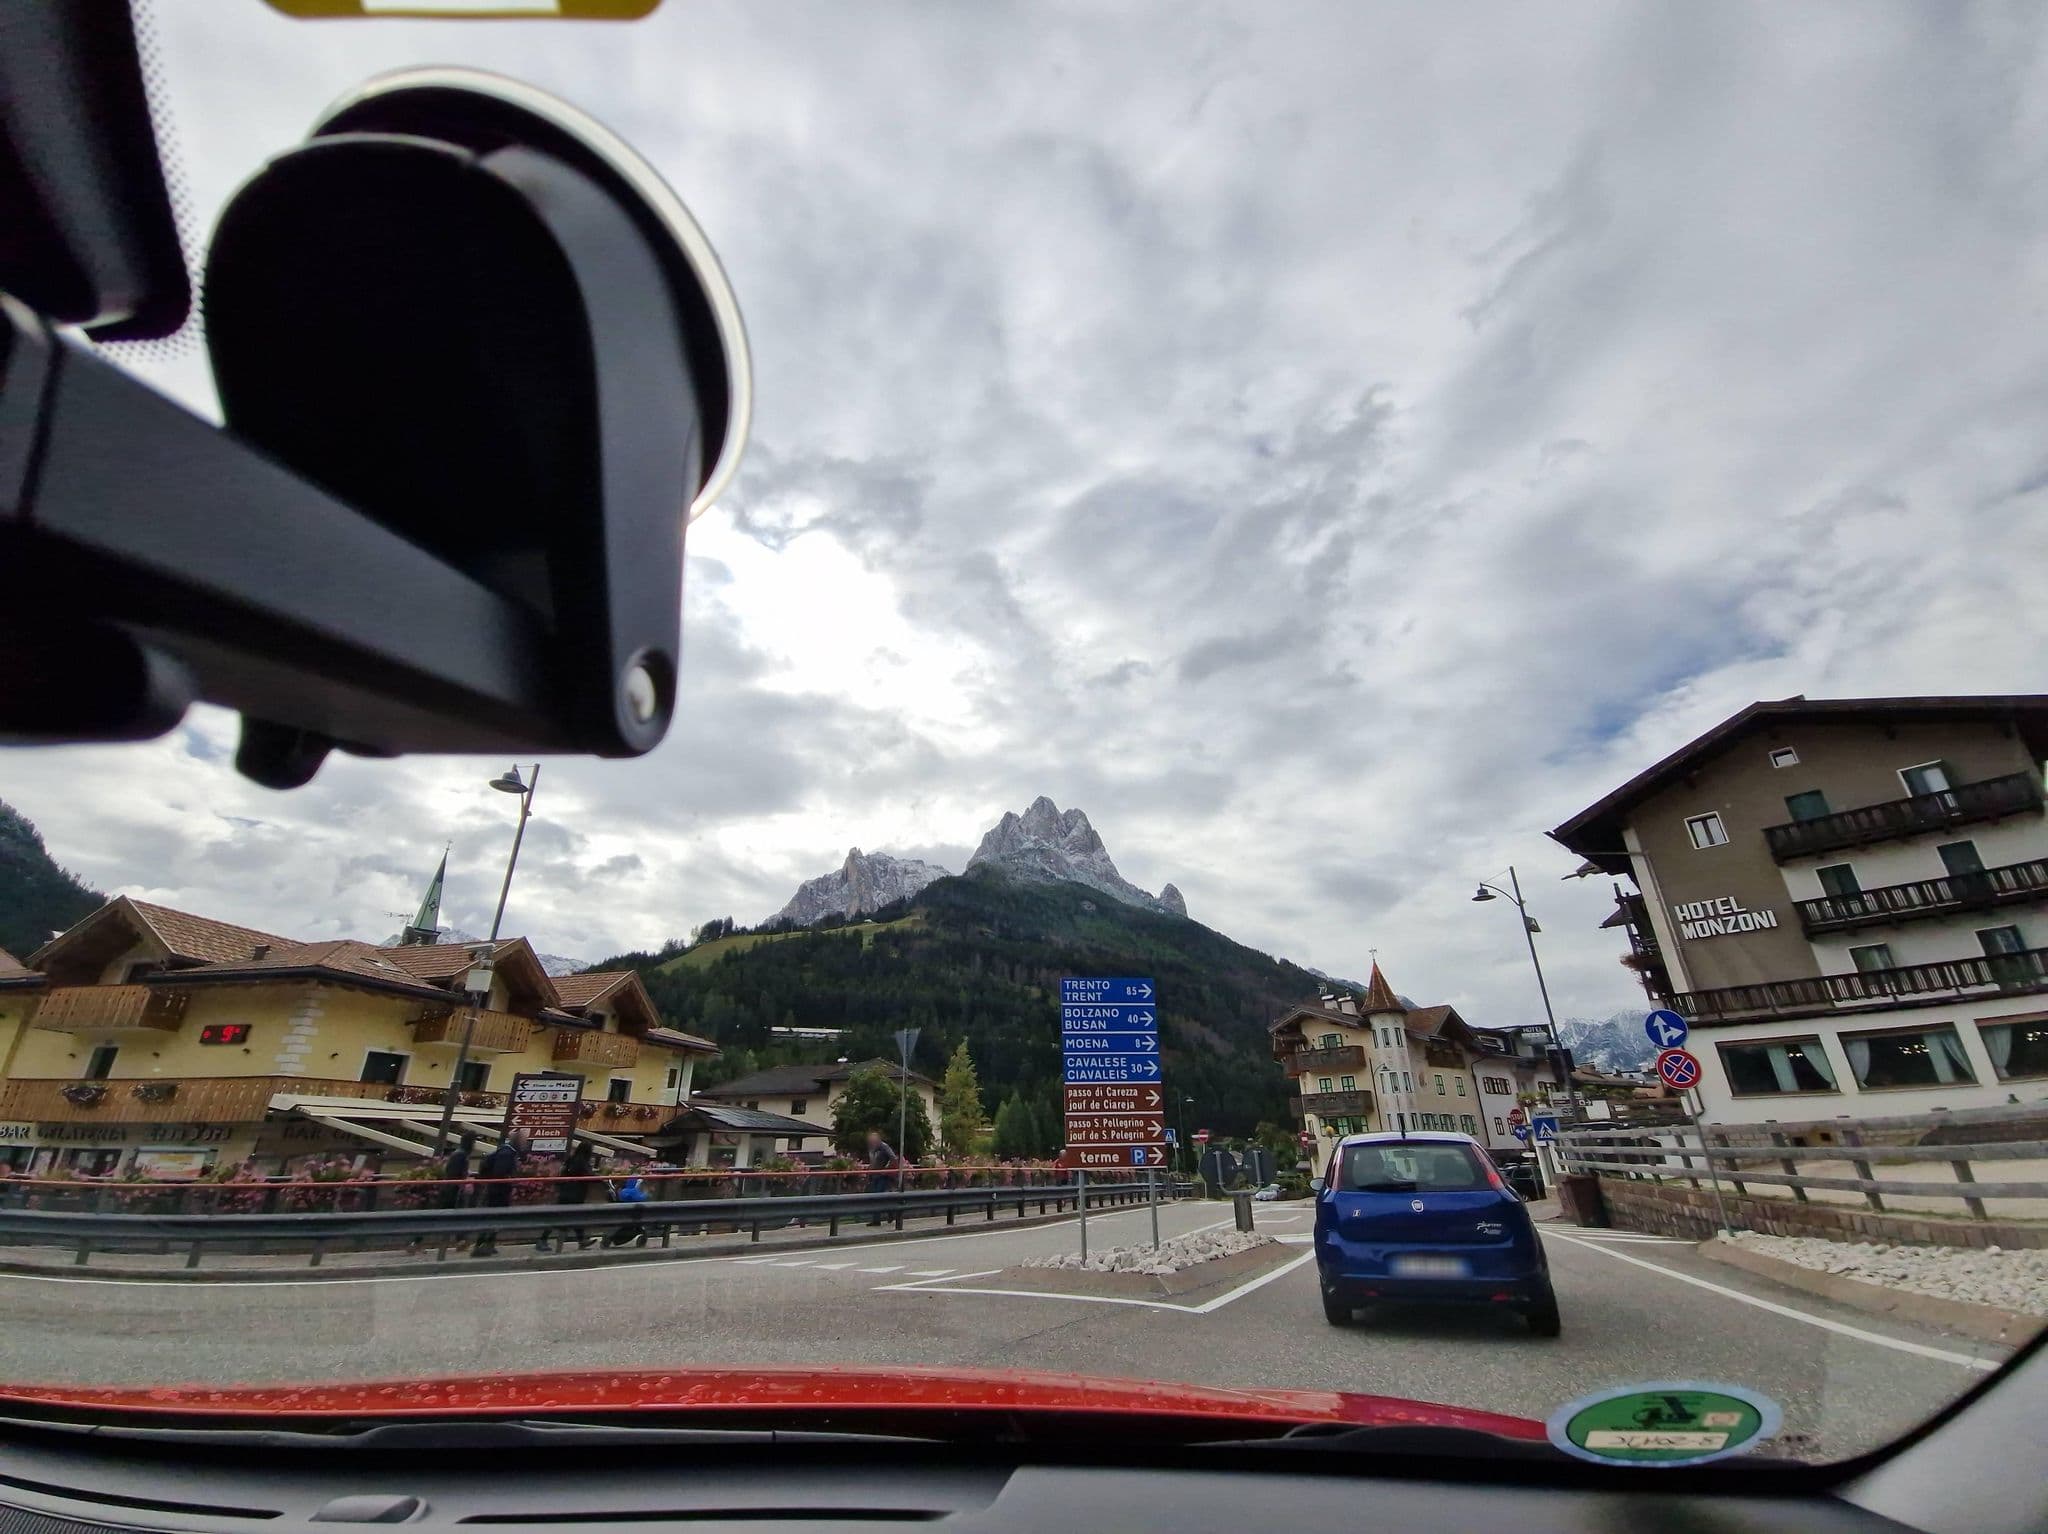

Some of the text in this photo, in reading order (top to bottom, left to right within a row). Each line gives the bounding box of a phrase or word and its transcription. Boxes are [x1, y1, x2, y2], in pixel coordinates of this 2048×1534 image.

[1674, 896, 1747, 921] HOTEL
[1680, 910, 1778, 940] MONZONI
[1064, 980, 1110, 990] TRENTO
[1064, 991, 1102, 1001] TRENT
[1126, 986, 1137, 996] 85
[1064, 1008, 1119, 1018] BOLZANO
[1127, 1014, 1138, 1024] 40
[1065, 1020, 1106, 1030] BUSAN
[1065, 1039, 1109, 1049] MOENA
[1135, 1038, 1141, 1048] 8
[1067, 1057, 1127, 1067] CAVALESE
[1130, 1063, 1143, 1073] 30
[1067, 1069, 1128, 1080] CIAVALEIS
[1068, 1086, 1138, 1099] passo di Carezza
[1068, 1098, 1135, 1112] jouf de Ciareja
[1068, 1119, 1092, 1130] passo
[1103, 1117, 1144, 1129] Pellegrino
[0, 1126, 31, 1139] BAR
[1069, 1130, 1087, 1143] jouf
[1089, 1129, 1100, 1140] de
[1111, 1128, 1144, 1141] Pelegrin
[1080, 1150, 1120, 1163] terme
